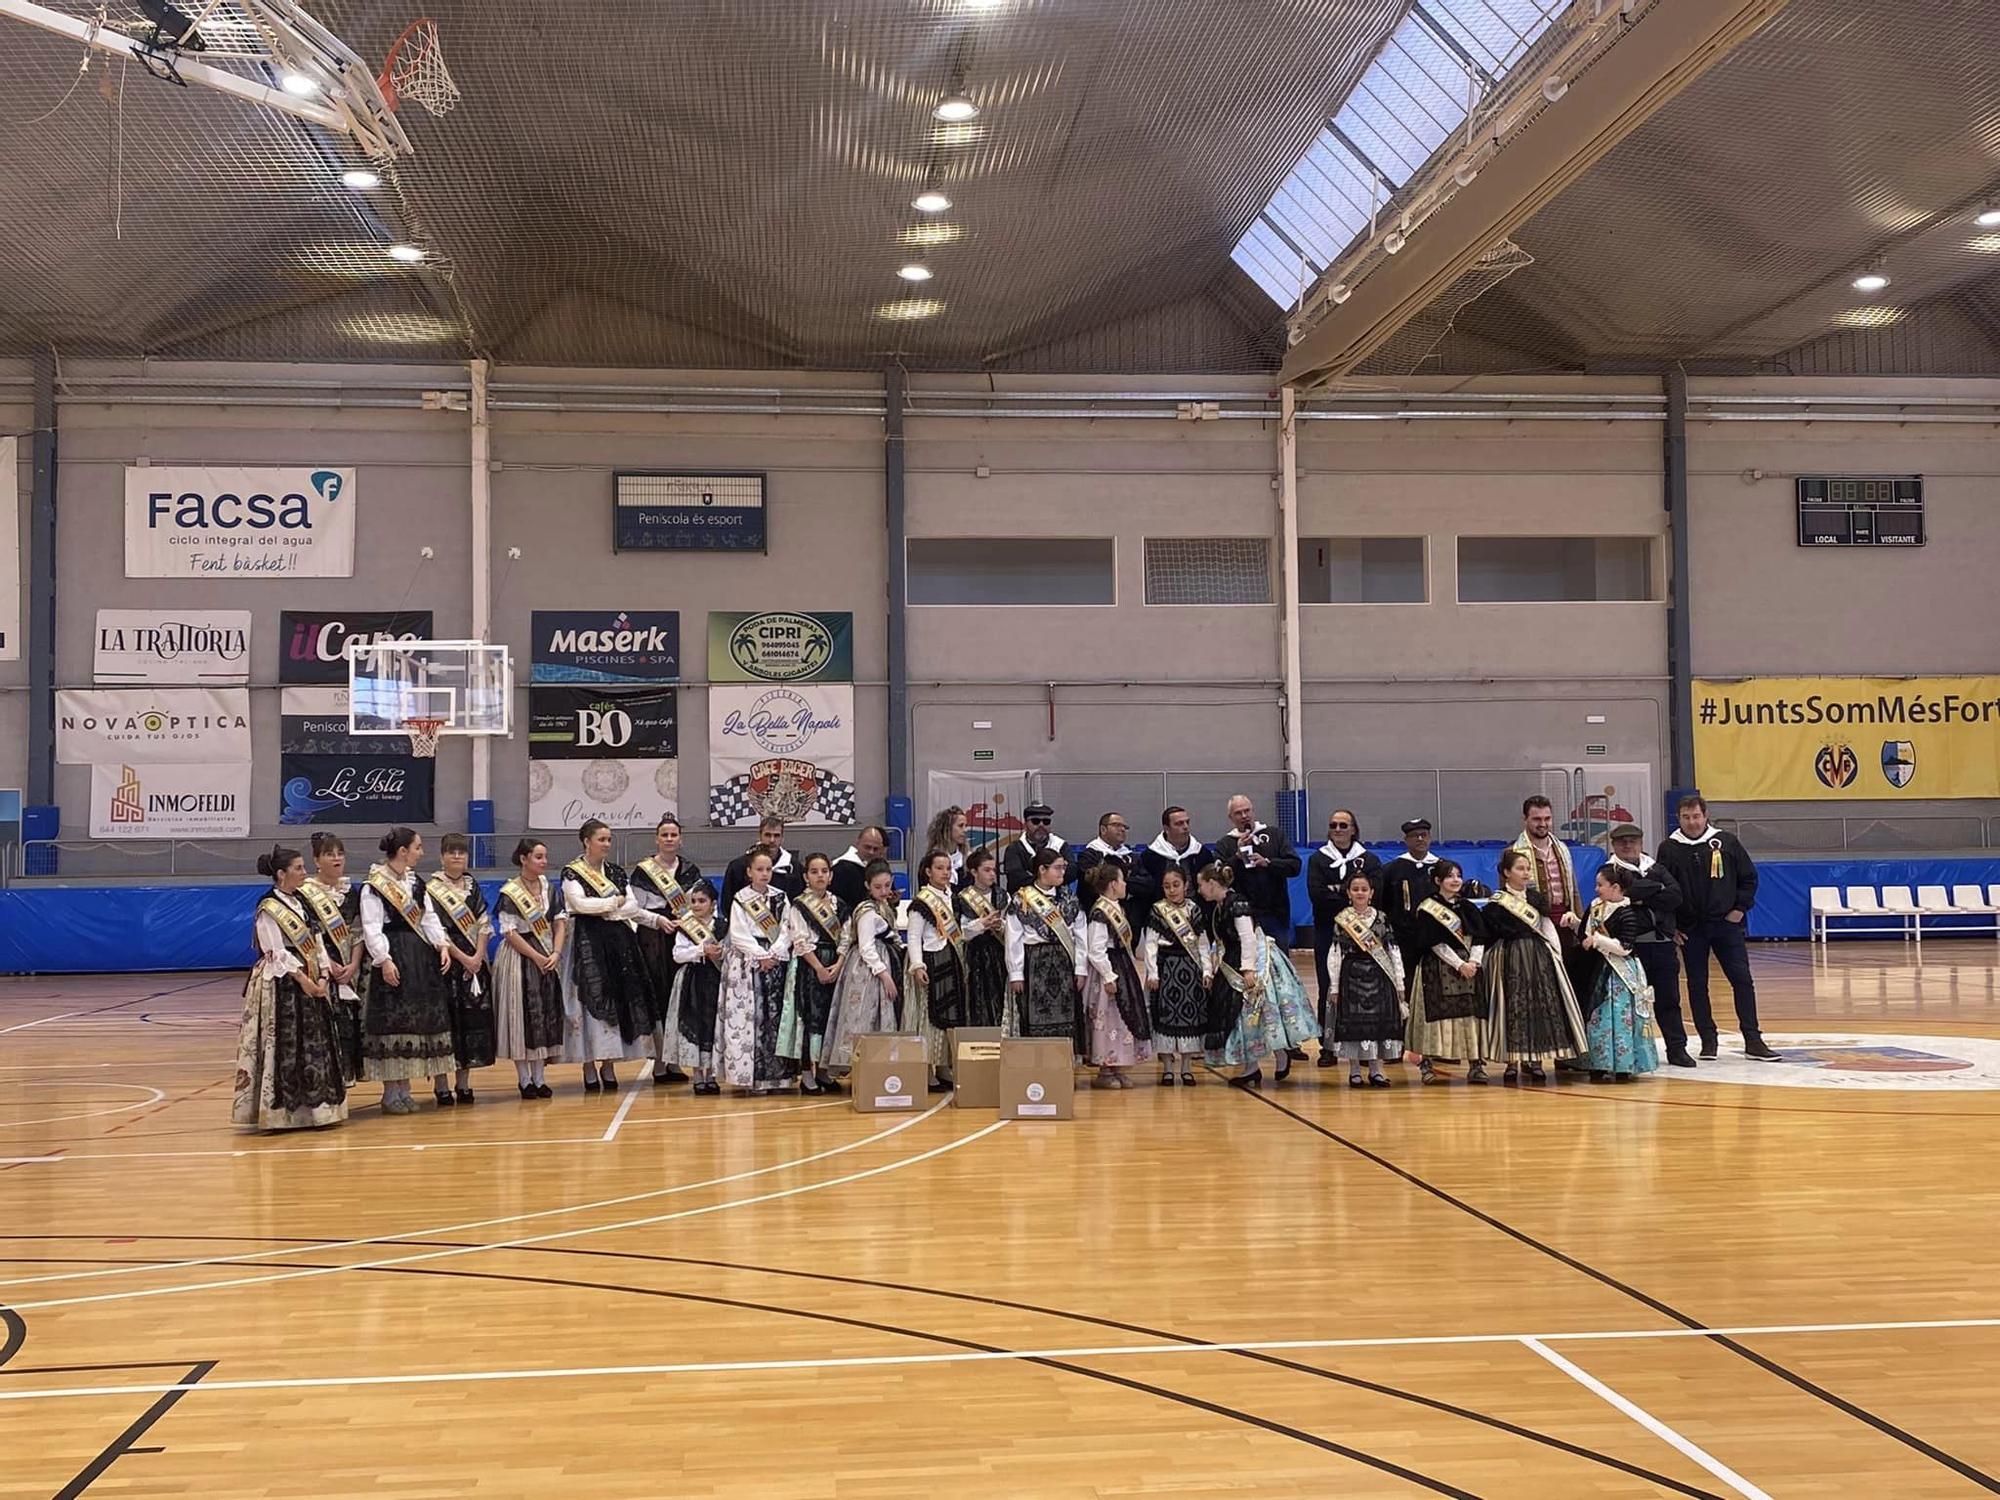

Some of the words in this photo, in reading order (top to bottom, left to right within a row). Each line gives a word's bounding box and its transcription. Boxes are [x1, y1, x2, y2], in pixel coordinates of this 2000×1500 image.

[707, 514, 744, 527] esport
[169, 535, 200, 545] ciclo
[205, 535, 254, 548] integral
[258, 535, 278, 546] del
[282, 537, 313, 548] agua
[1815, 535, 1838, 544] LOCAL
[1881, 535, 1917, 544] VISITANTE
[190, 553, 228, 571] Fent
[743, 620, 766, 633] PODA
[766, 617, 777, 625] DE
[758, 627, 802, 639] CIPRI
[101, 629, 126, 652] LA
[133, 622, 247, 660] TRATTORIA
[549, 626, 668, 653] Maserk
[575, 655, 636, 664] PISCINES
[650, 655, 676, 664] SPA
[722, 710, 748, 737] La
[748, 710, 790, 737] Bella
[791, 708, 841, 736] Napoli
[107, 733, 141, 741] CUIDA
[780, 760, 814, 779] RACER
[315, 767, 360, 808] La
[148, 794, 236, 812] INMOFELDI
